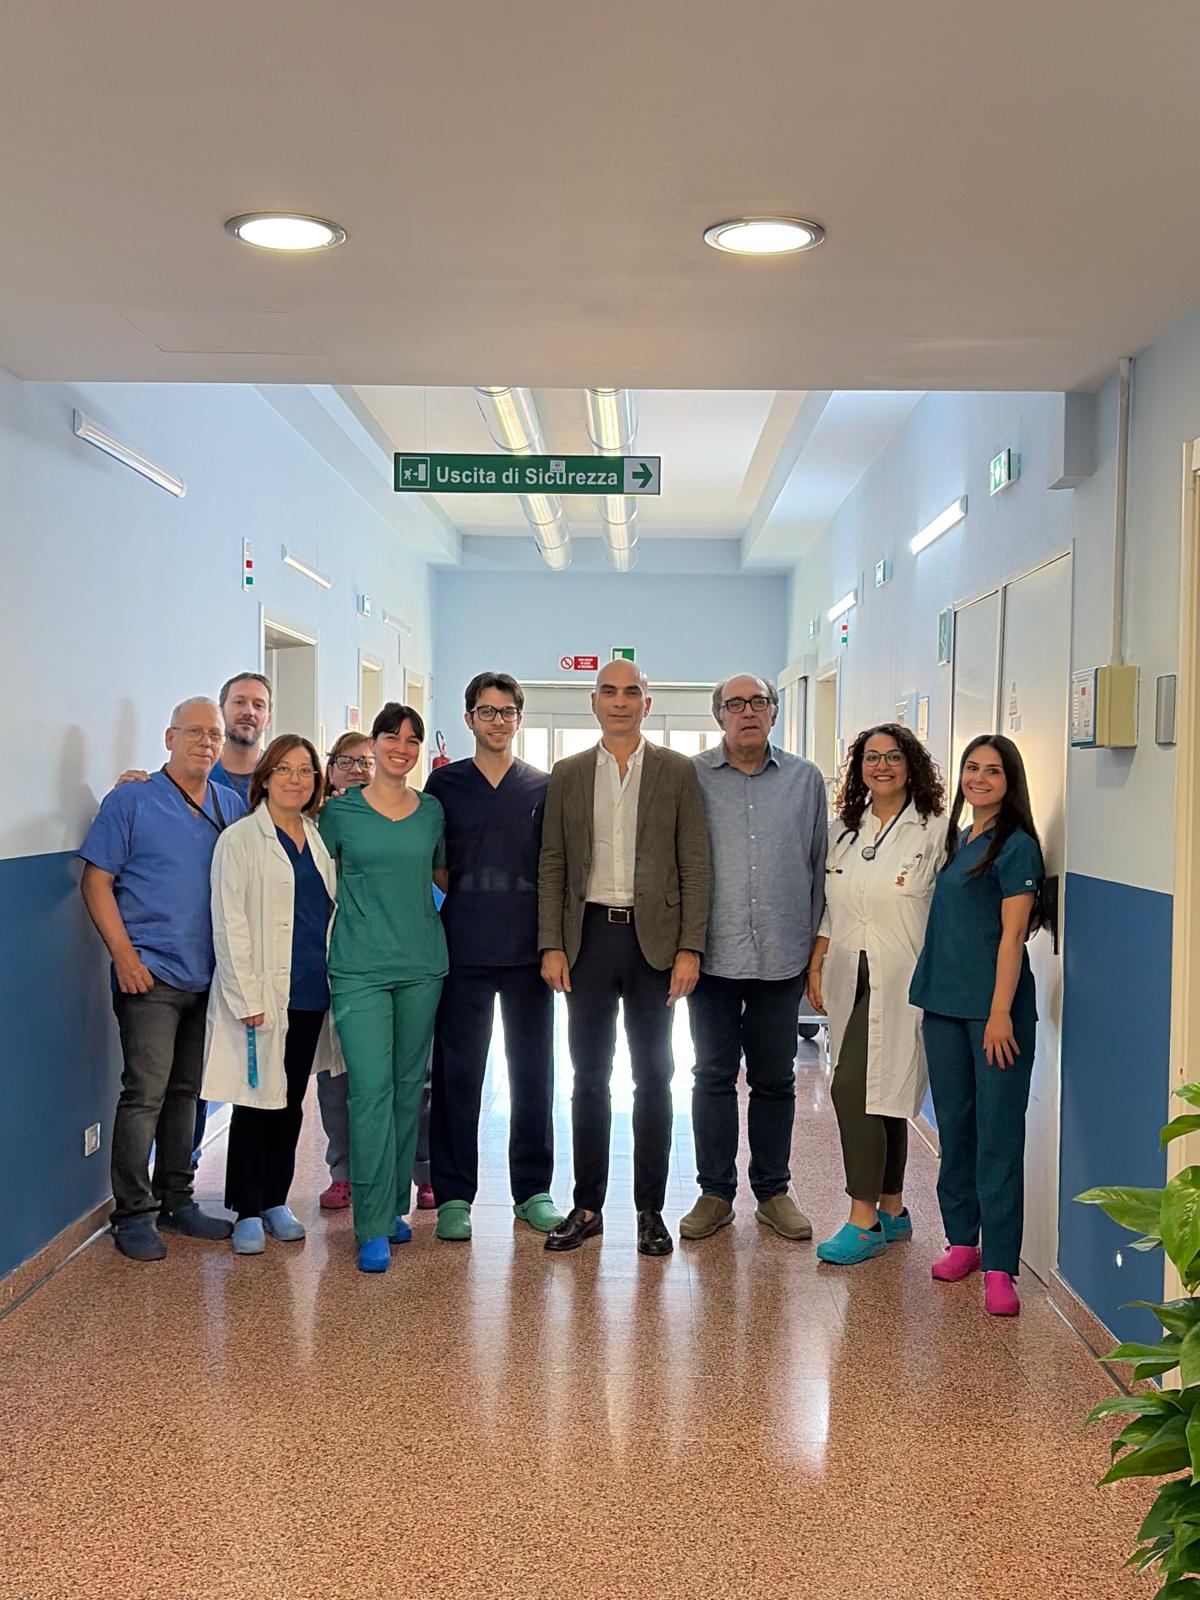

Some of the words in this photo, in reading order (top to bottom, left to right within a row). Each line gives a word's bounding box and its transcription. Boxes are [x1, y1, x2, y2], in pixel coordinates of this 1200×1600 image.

[436, 466, 496, 484] Uscita
[502, 467, 519, 484] di
[525, 467, 618, 485] Sicurezza
